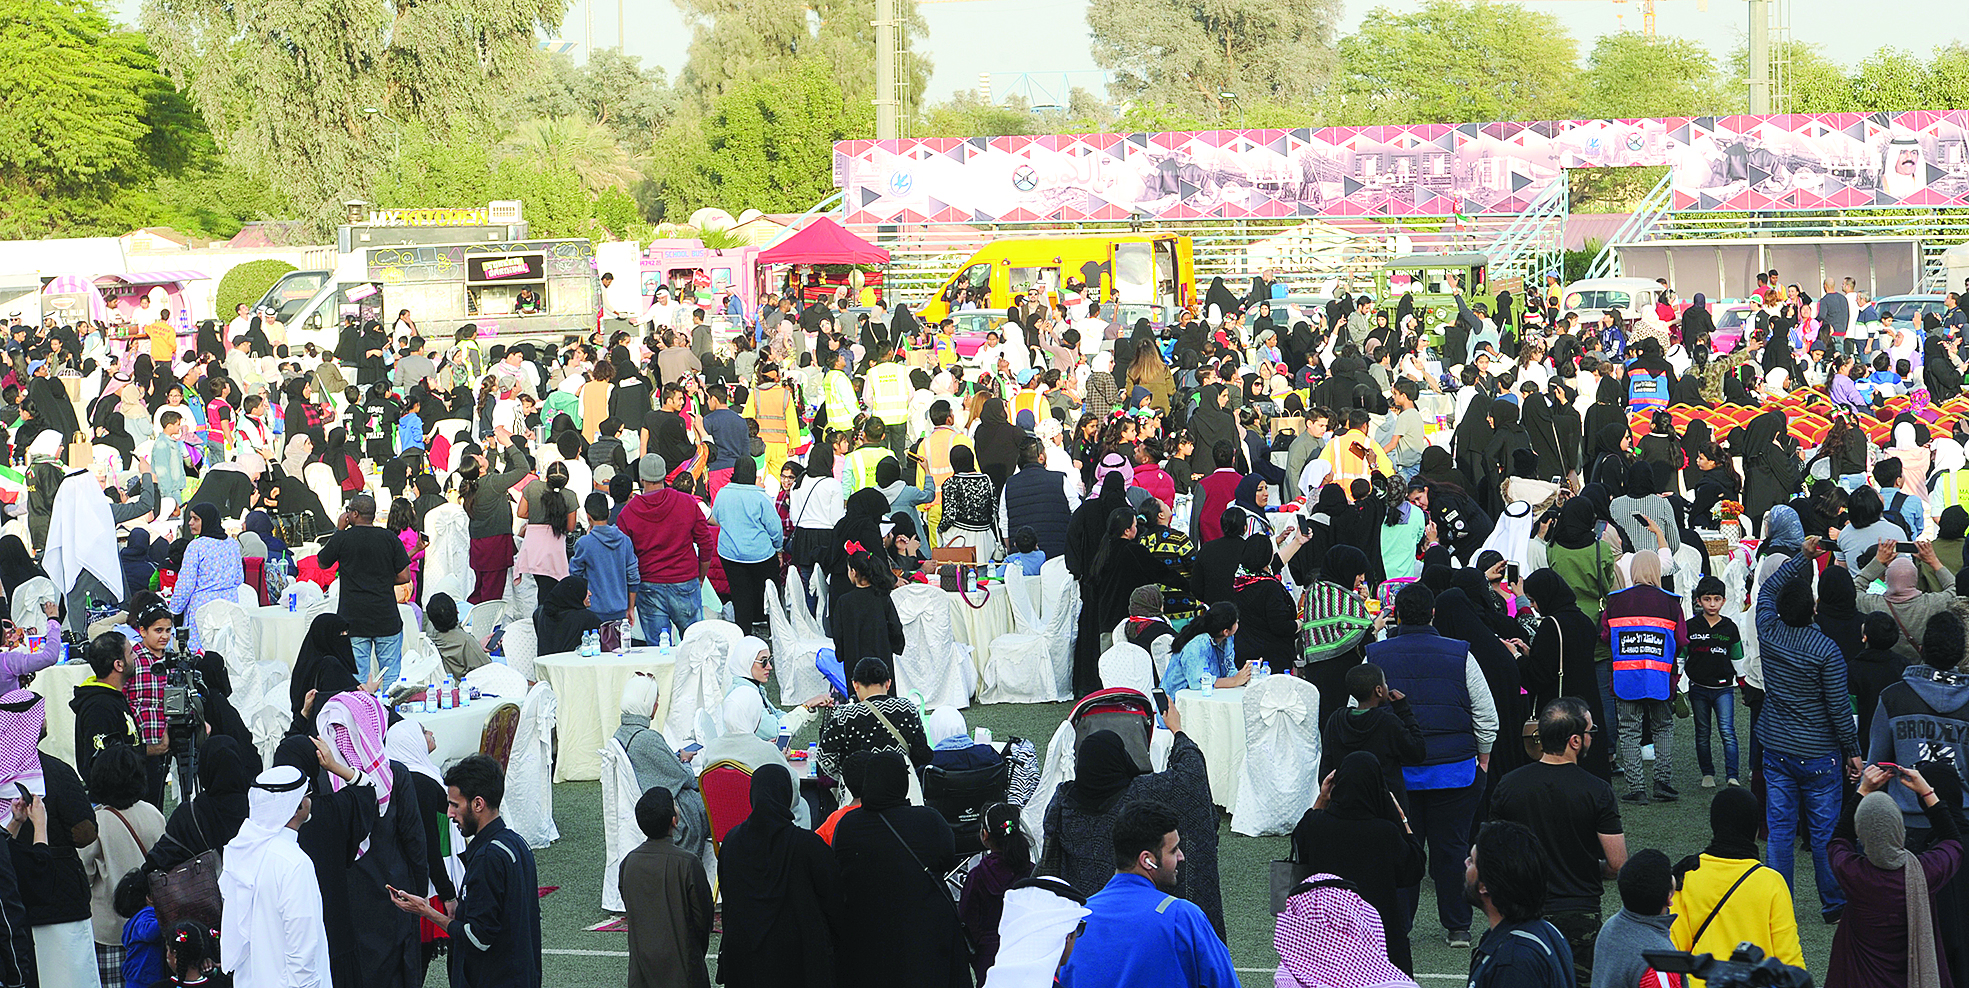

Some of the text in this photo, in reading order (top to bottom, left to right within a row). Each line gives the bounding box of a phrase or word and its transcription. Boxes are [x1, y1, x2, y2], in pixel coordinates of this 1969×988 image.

[369, 210, 489, 227] MY KITCHEN
[665, 250, 689, 258] SCHOOL
[1690, 633, 1710, 641] عيدك
